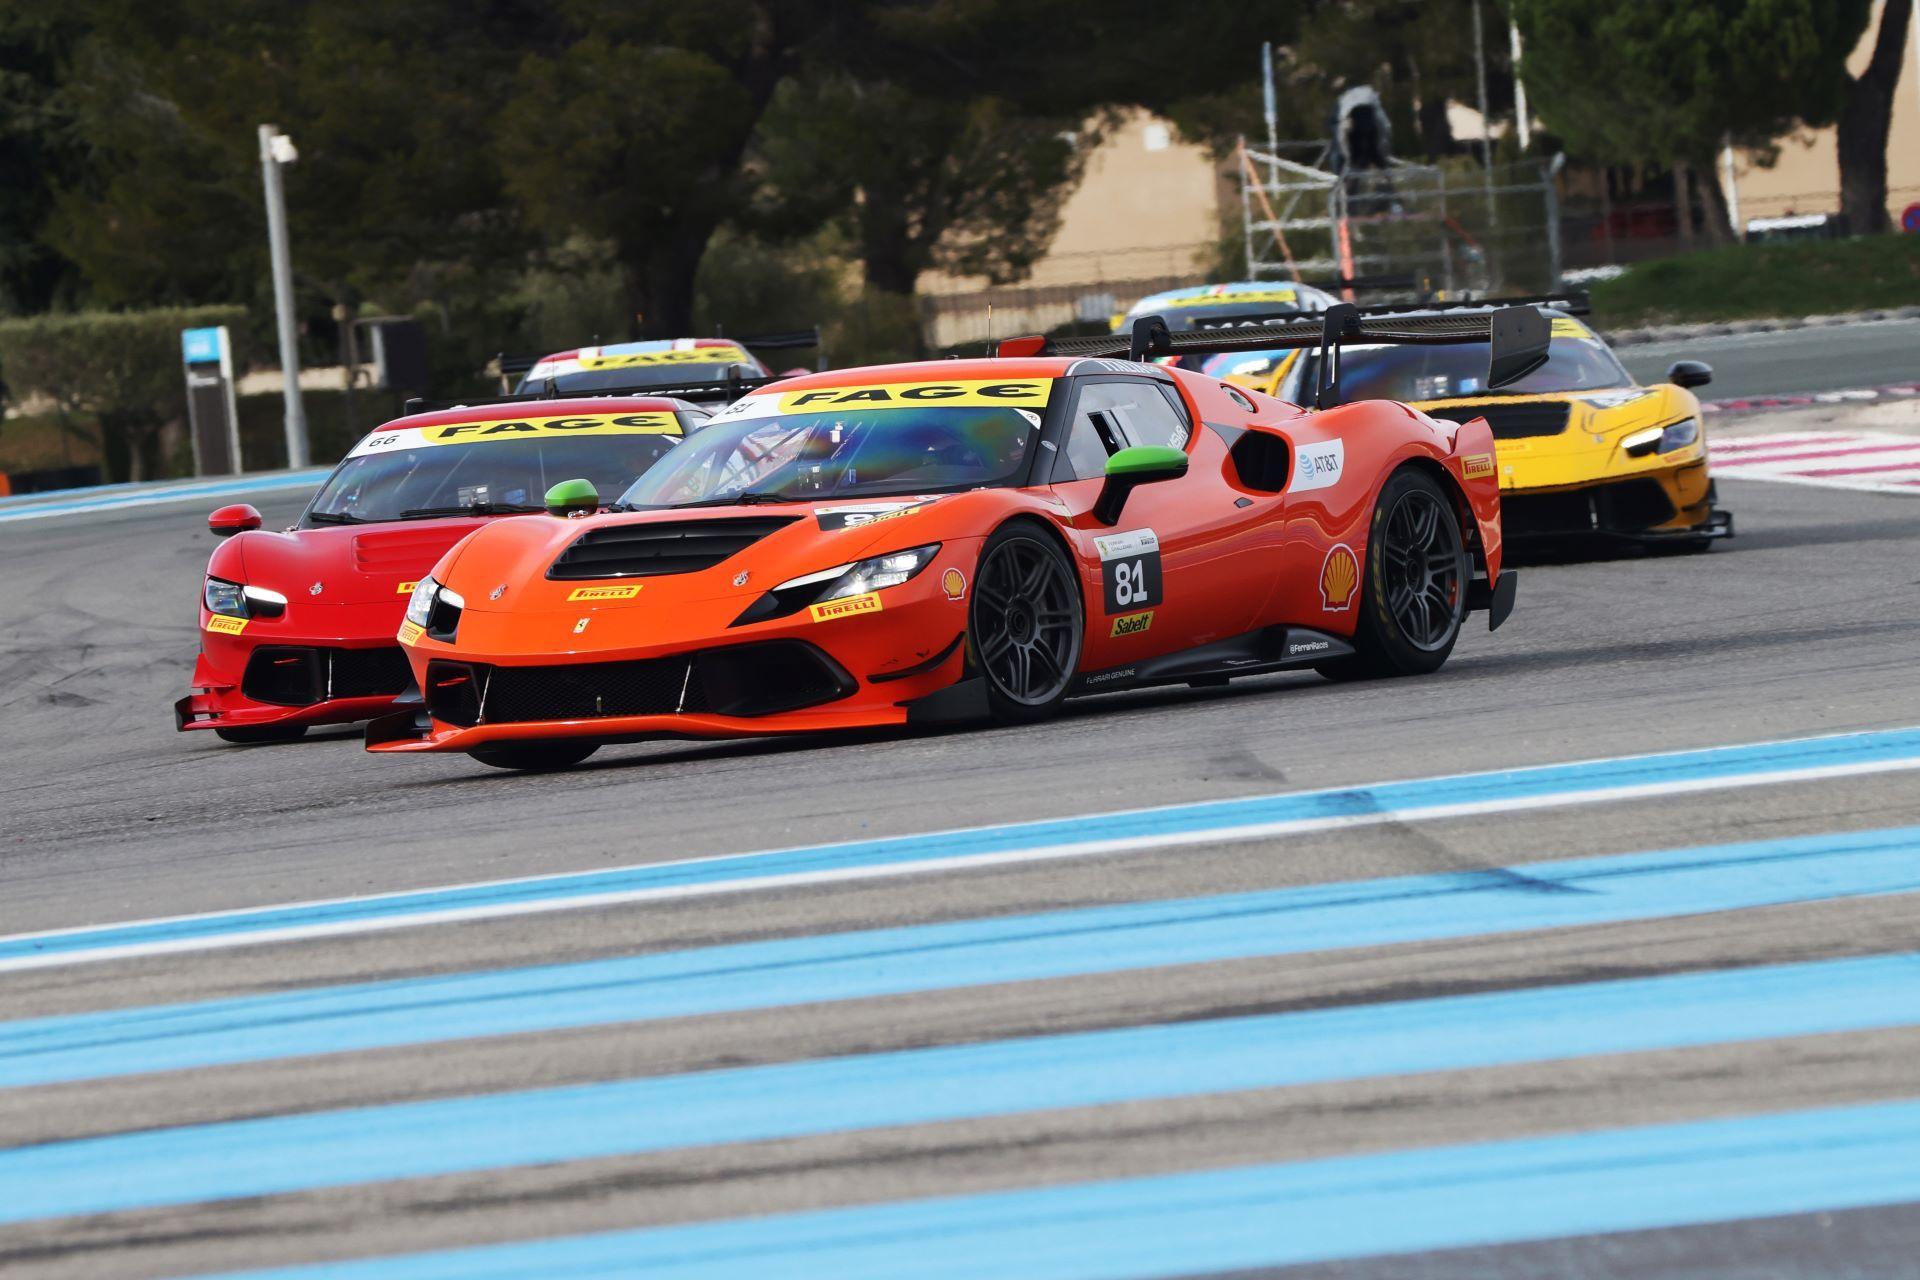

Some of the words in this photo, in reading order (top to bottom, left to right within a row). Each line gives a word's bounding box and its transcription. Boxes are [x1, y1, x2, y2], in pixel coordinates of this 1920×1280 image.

[790, 383, 1044, 407] FAGE
[438, 415, 669, 438] FAGE
[368, 435, 397, 448] 66
[1314, 453, 1339, 474] AT&T
[1464, 457, 1491, 475] PIRELLI
[575, 587, 635, 599] PIRELLI
[1115, 559, 1148, 606] 81
[817, 595, 877, 617] PIRELLI
[211, 617, 243, 632] PIRELLI
[1115, 614, 1149, 635] Sabelt
